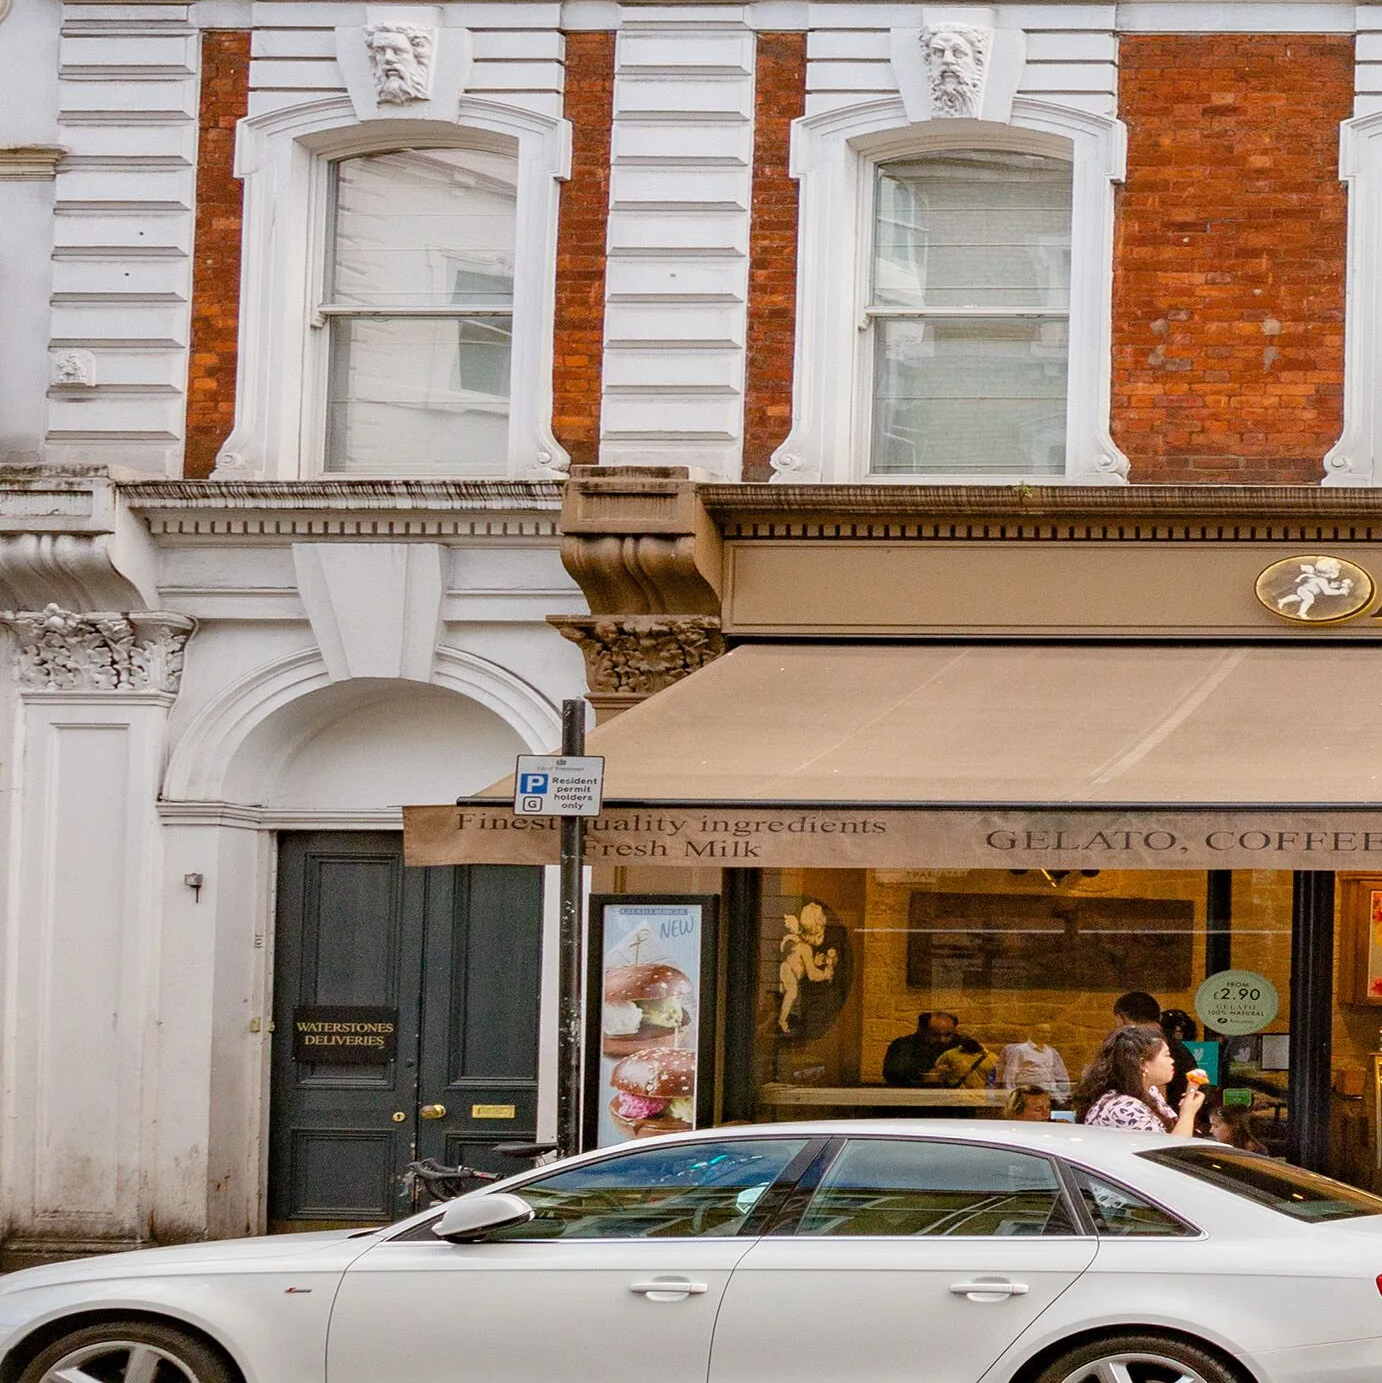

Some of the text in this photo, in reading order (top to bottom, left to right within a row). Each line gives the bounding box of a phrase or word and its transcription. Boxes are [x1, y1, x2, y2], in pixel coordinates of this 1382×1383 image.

[526, 775, 545, 792] P
[552, 777, 598, 785] Resident
[556, 785, 591, 793] permit
[554, 793, 593, 801] holders
[527, 800, 538, 809] G
[561, 802, 584, 810] only
[456, 813, 557, 831] Finest
[700, 814, 887, 836] ingredients
[985, 829, 1189, 854] GELATO,
[581, 839, 761, 858] Fresh Milk
[660, 917, 695, 939] NEW
[1213, 987, 1261, 1001] £2.90
[296, 1022, 394, 1033] WATERSTONES
[304, 1035, 385, 1046] DELIVERIES
